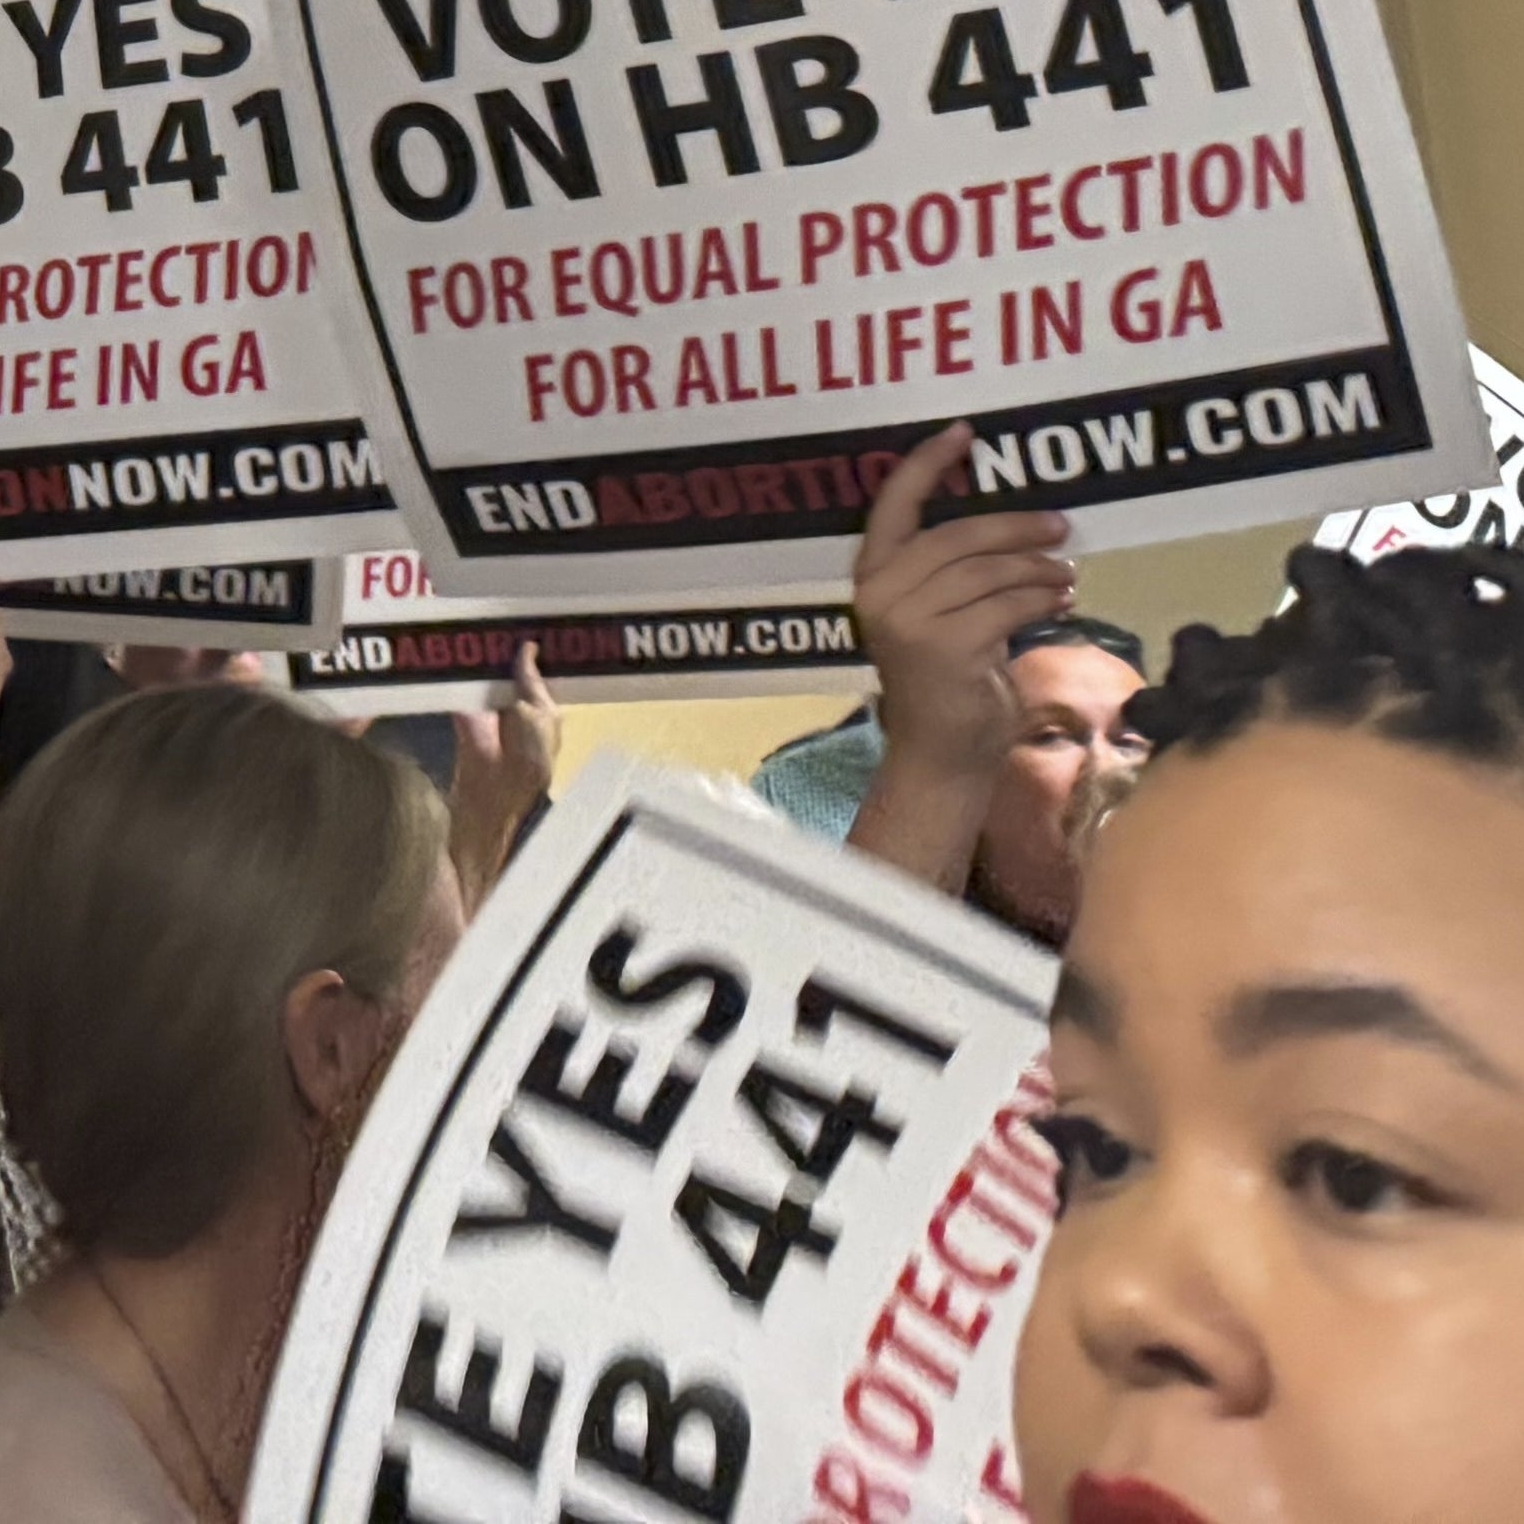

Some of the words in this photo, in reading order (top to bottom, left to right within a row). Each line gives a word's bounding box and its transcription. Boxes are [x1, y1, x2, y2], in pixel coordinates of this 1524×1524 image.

[59, 88, 300, 214] 441
[368, 76, 603, 224] ON
[627, 29, 881, 189] HB
[407, 252, 534, 337] FOR
[551, 223, 781, 322] EQUAL
[797, 126, 1308, 287] PROTECTION
[97, 340, 160, 405] IN
[181, 329, 268, 396] GA
[524, 339, 657, 425] FOR
[675, 324, 797, 409] ALL
[815, 297, 974, 395] LIFE
[998, 280, 1085, 366] IN
[1109, 257, 1225, 346] GA
[442, 918, 749, 1263] YES
[672, 970, 963, 1310] 441
